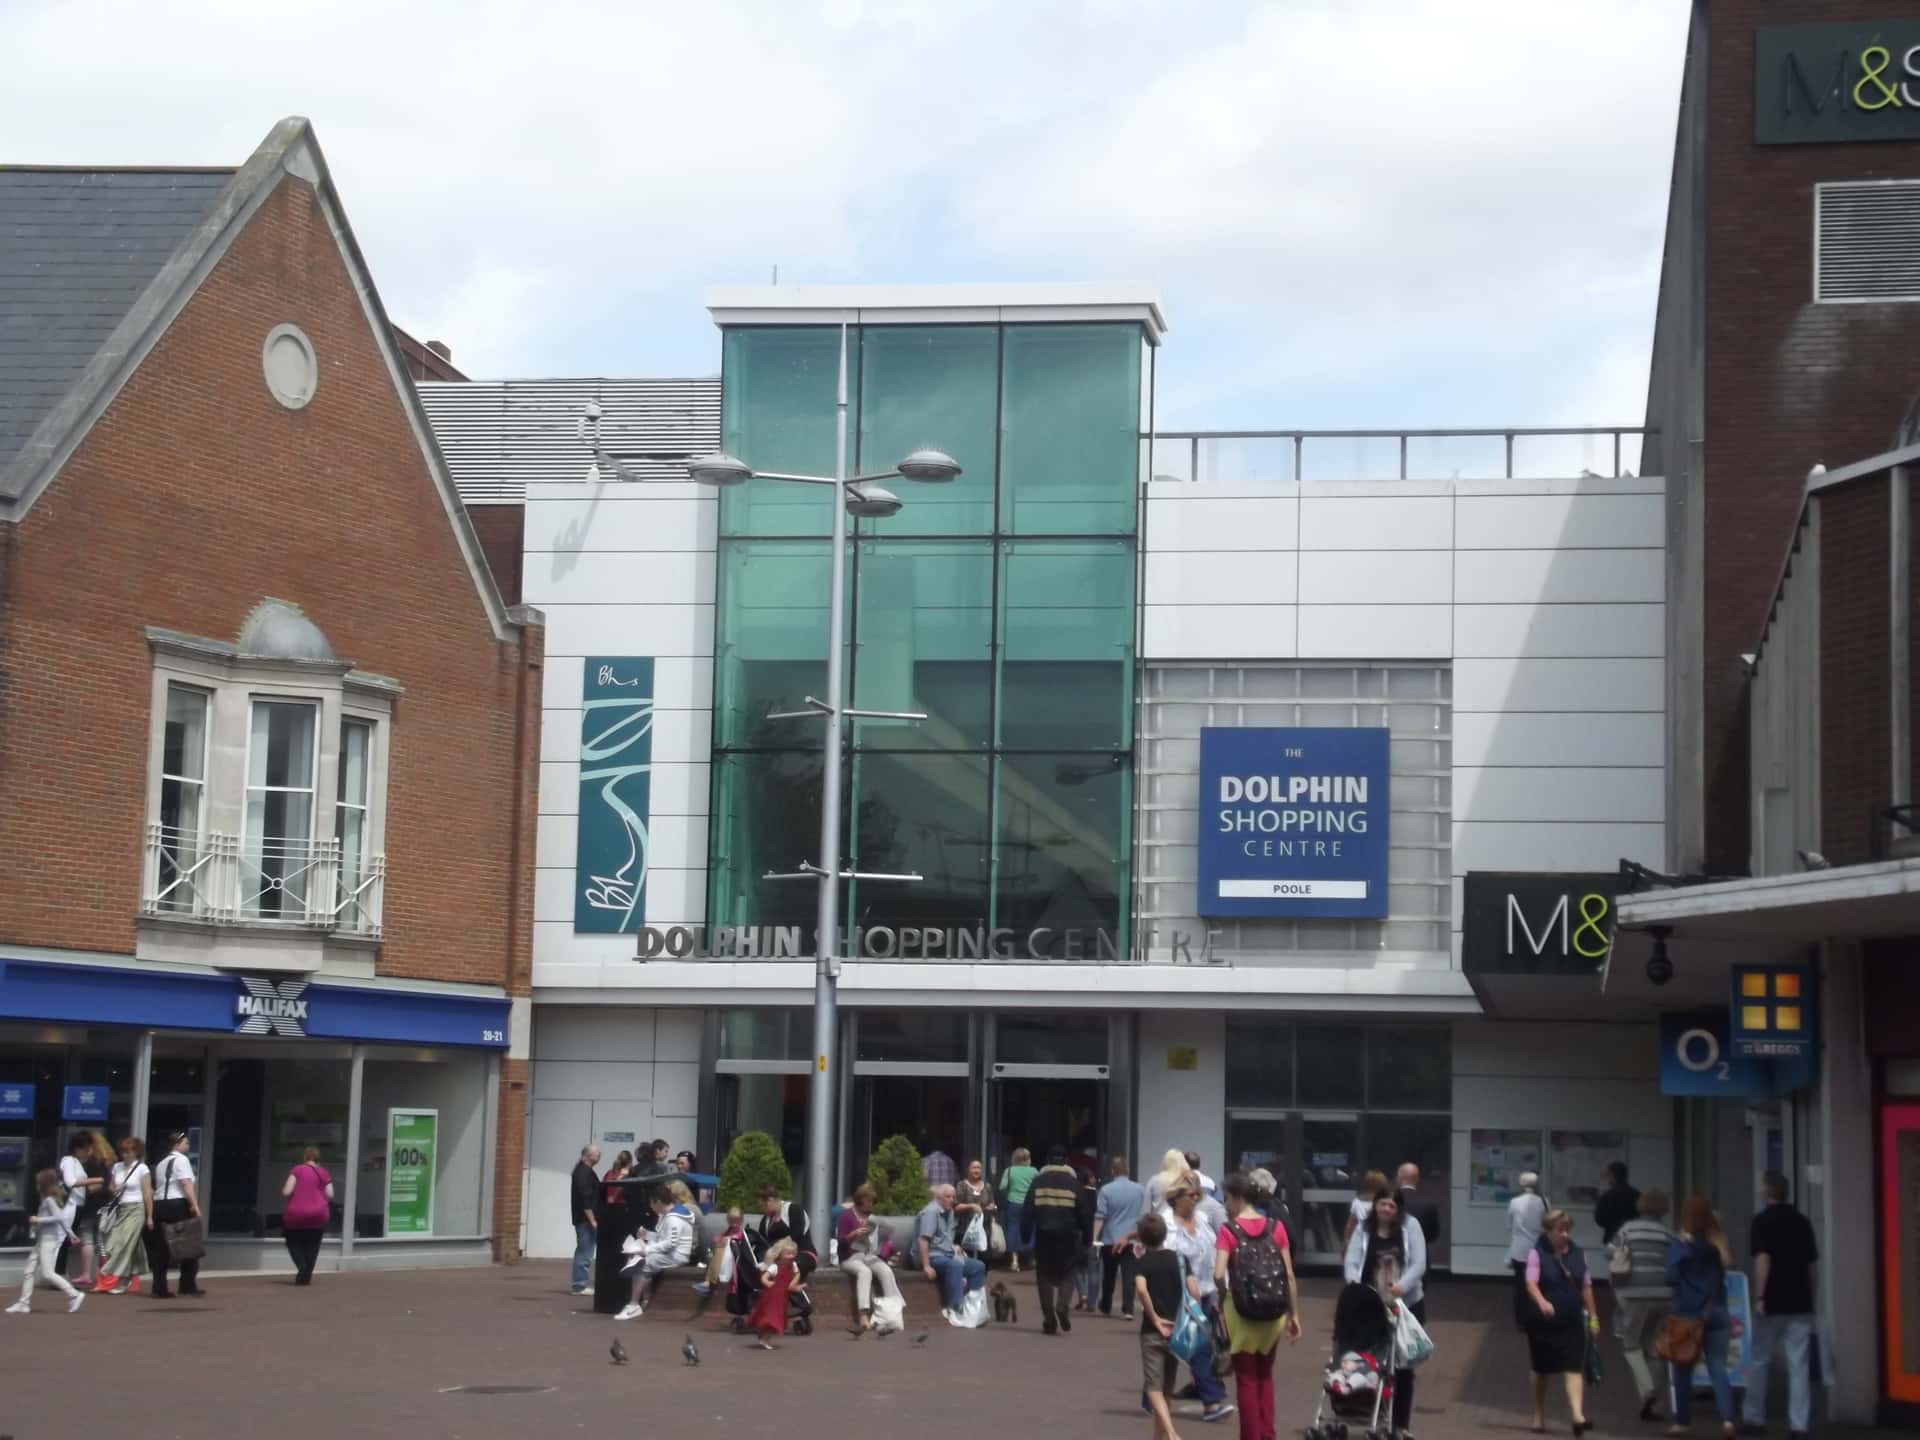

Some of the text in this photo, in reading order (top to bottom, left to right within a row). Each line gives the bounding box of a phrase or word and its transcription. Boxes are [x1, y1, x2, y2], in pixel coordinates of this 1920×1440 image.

[598, 665, 639, 686] Bhs
[1285, 748, 1304, 758] THE
[1219, 776, 1368, 803] DOLPHIN
[1219, 810, 1368, 833] SHOPPING
[1244, 840, 1342, 857] CENTRE
[1273, 884, 1312, 895] POOLE
[636, 926, 1223, 963] DOLPHIN HOPPING CENTRE
[238, 996, 307, 1019] HALIFAX
[483, 1030, 503, 1041] 20-21
[394, 1147, 428, 1166] 100%
